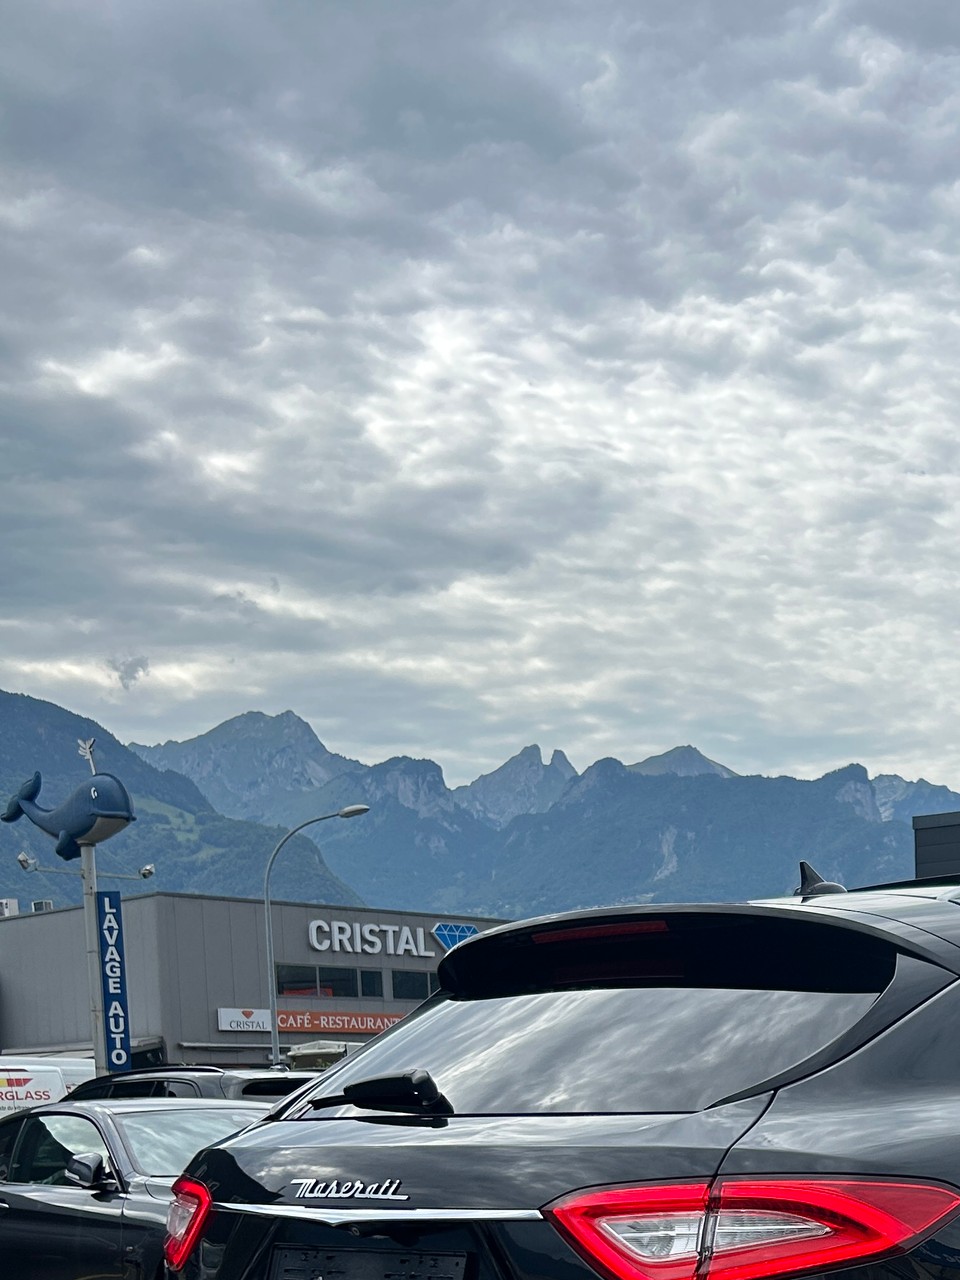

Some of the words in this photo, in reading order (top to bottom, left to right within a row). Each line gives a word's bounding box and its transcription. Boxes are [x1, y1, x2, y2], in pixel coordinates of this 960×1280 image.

[102, 897, 122, 994] LAVAGE
[308, 919, 436, 957] CRISTAL
[108, 1001, 127, 1065] AUTO
[229, 1020, 268, 1030] CRISTAL
[278, 1012, 312, 1028] CAFÉ
[290, 1179, 409, 1200] Maserati
